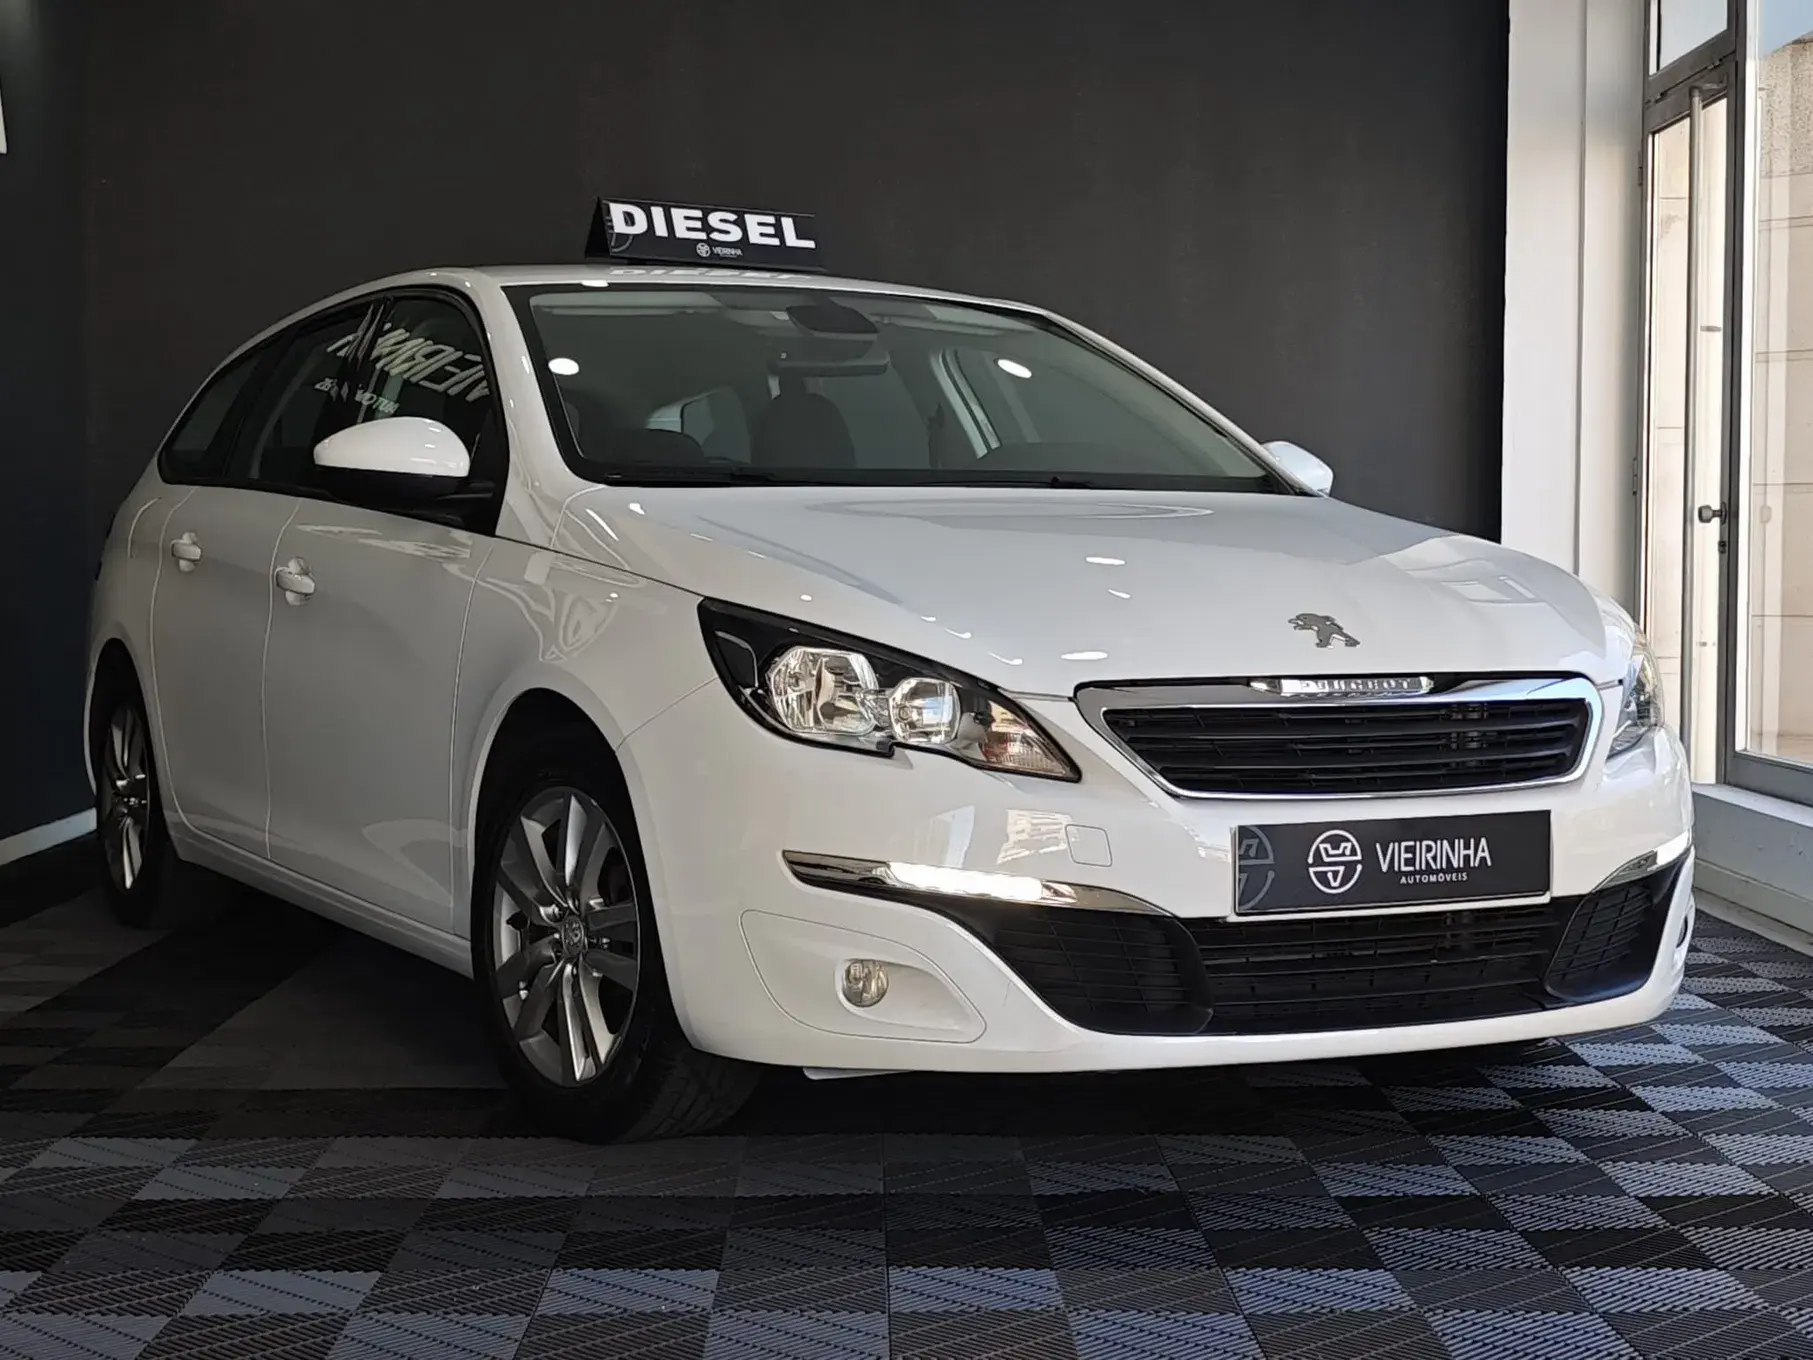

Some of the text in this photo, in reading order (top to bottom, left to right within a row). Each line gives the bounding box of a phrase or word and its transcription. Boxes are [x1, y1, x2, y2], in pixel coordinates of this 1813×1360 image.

[608, 202, 816, 249] DIESEL
[1375, 837, 1492, 873] VIEIRINHA
[1399, 872, 1468, 885] AUTOMÓVEIS
